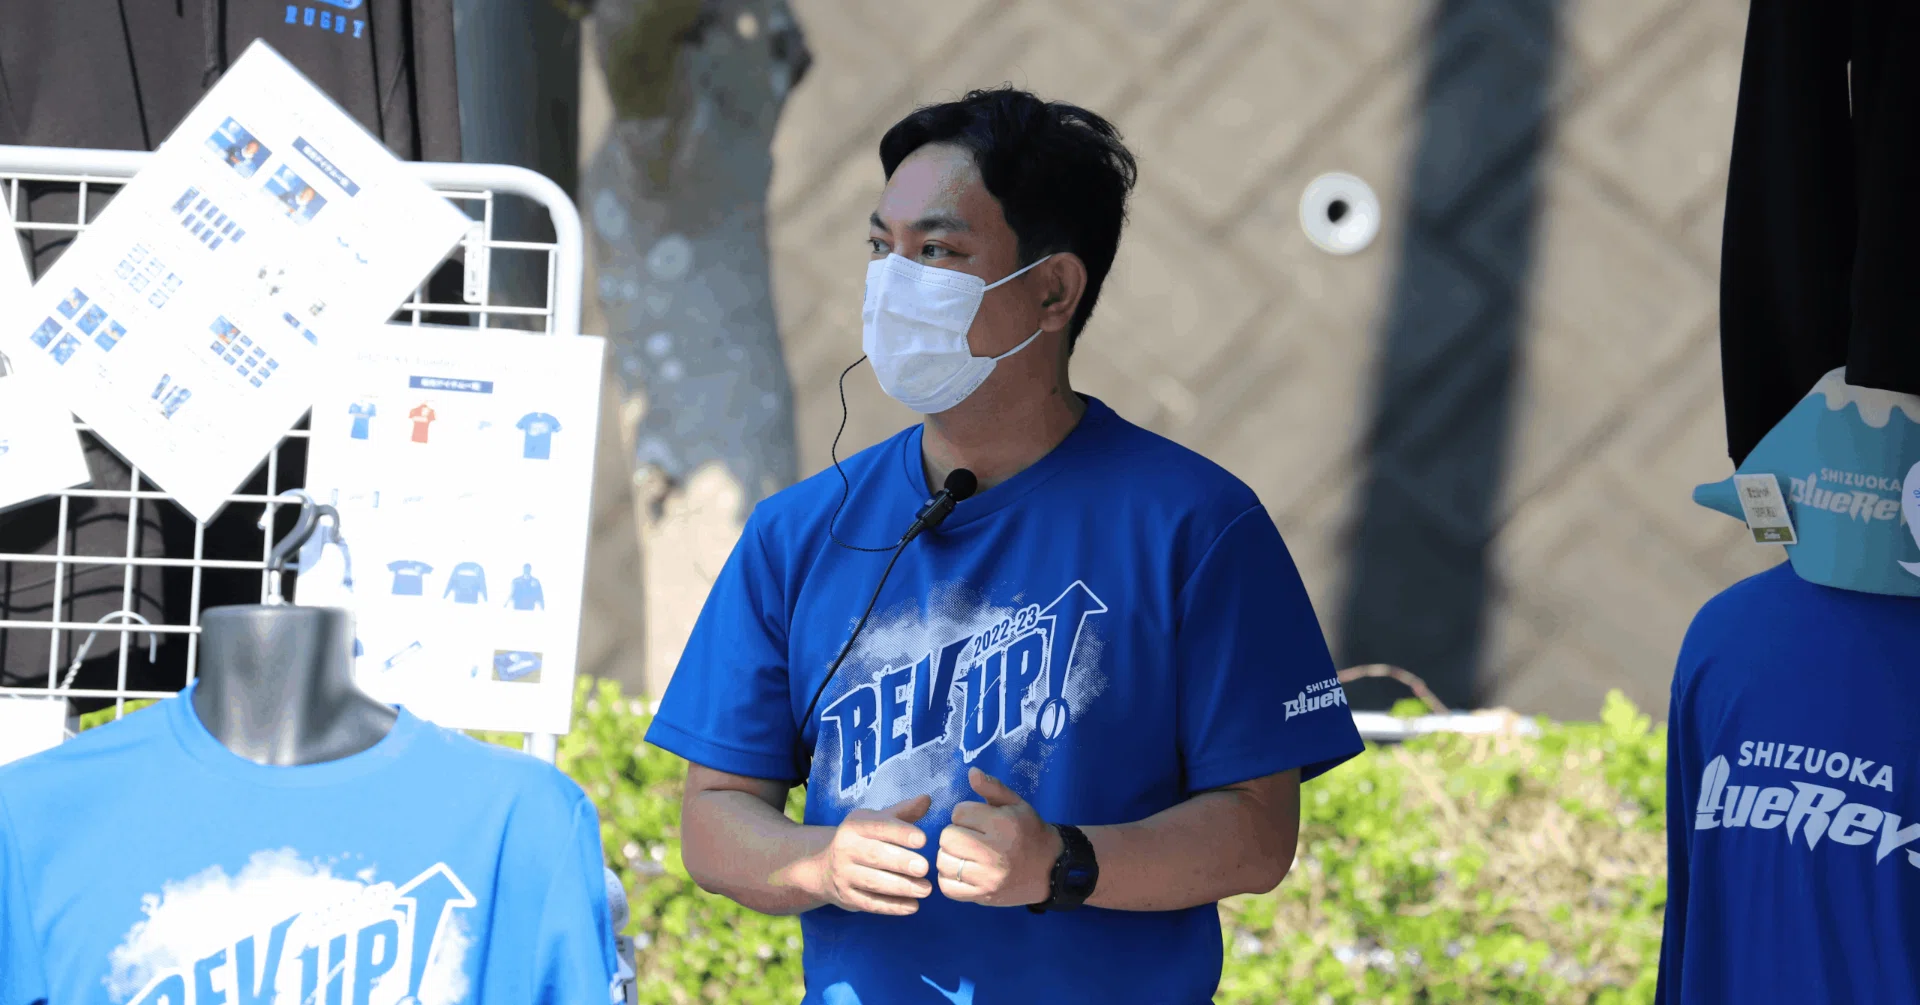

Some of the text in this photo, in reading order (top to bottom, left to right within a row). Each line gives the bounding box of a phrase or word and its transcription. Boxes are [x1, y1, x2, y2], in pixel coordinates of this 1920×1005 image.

[1789, 472, 1908, 527] BlueRe
[1820, 467, 1902, 493] SHIZUOKA
[973, 605, 1038, 660] 2022-23
[821, 632, 976, 799] REV
[1737, 740, 1893, 792] SHIZUOKA
